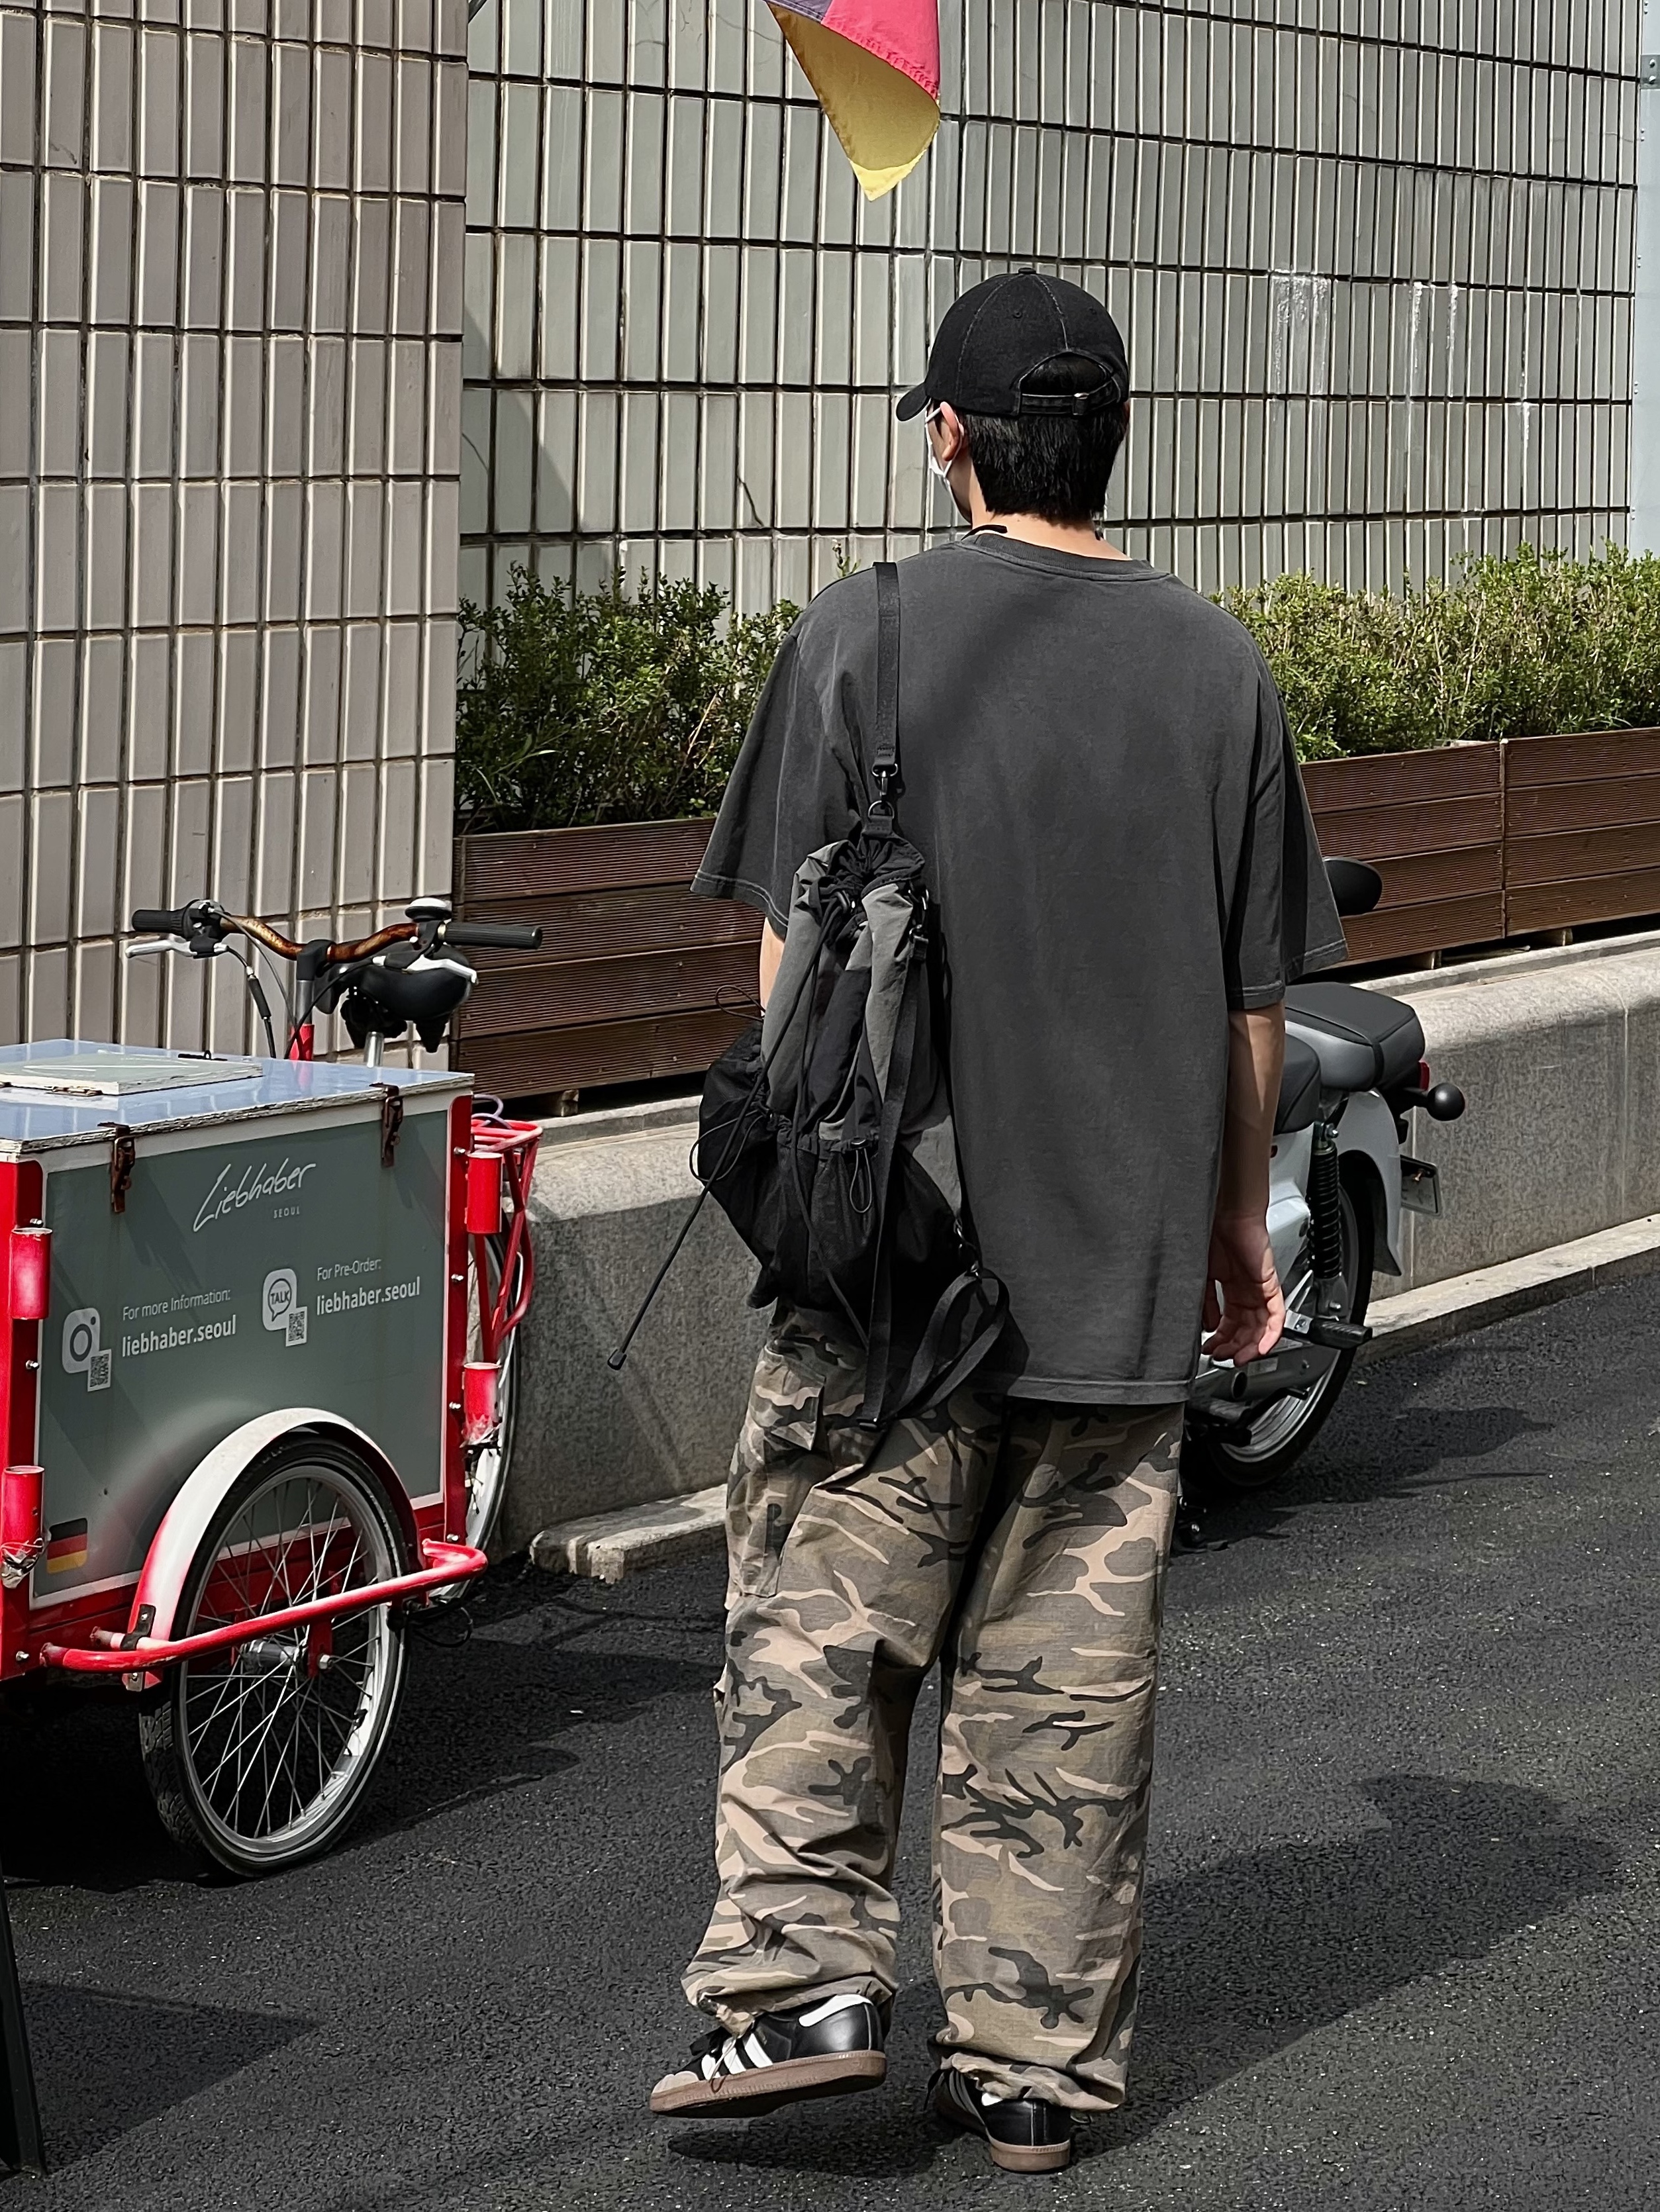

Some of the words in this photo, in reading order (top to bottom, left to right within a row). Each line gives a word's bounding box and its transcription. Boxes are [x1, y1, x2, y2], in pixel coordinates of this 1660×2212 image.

[193, 1157, 317, 1232] Liebhaber
[273, 1206, 300, 1219] SEOUL
[317, 1267, 332, 1281] For
[334, 1257, 382, 1278] Pre-Order:
[122, 1306, 140, 1321] For
[142, 1301, 168, 1318] more
[170, 1289, 231, 1311] Information:
[270, 1290, 290, 1305] TALK
[317, 1276, 420, 1316] liebhaber.seoul
[122, 1314, 236, 1357] liebhaber.seoul
